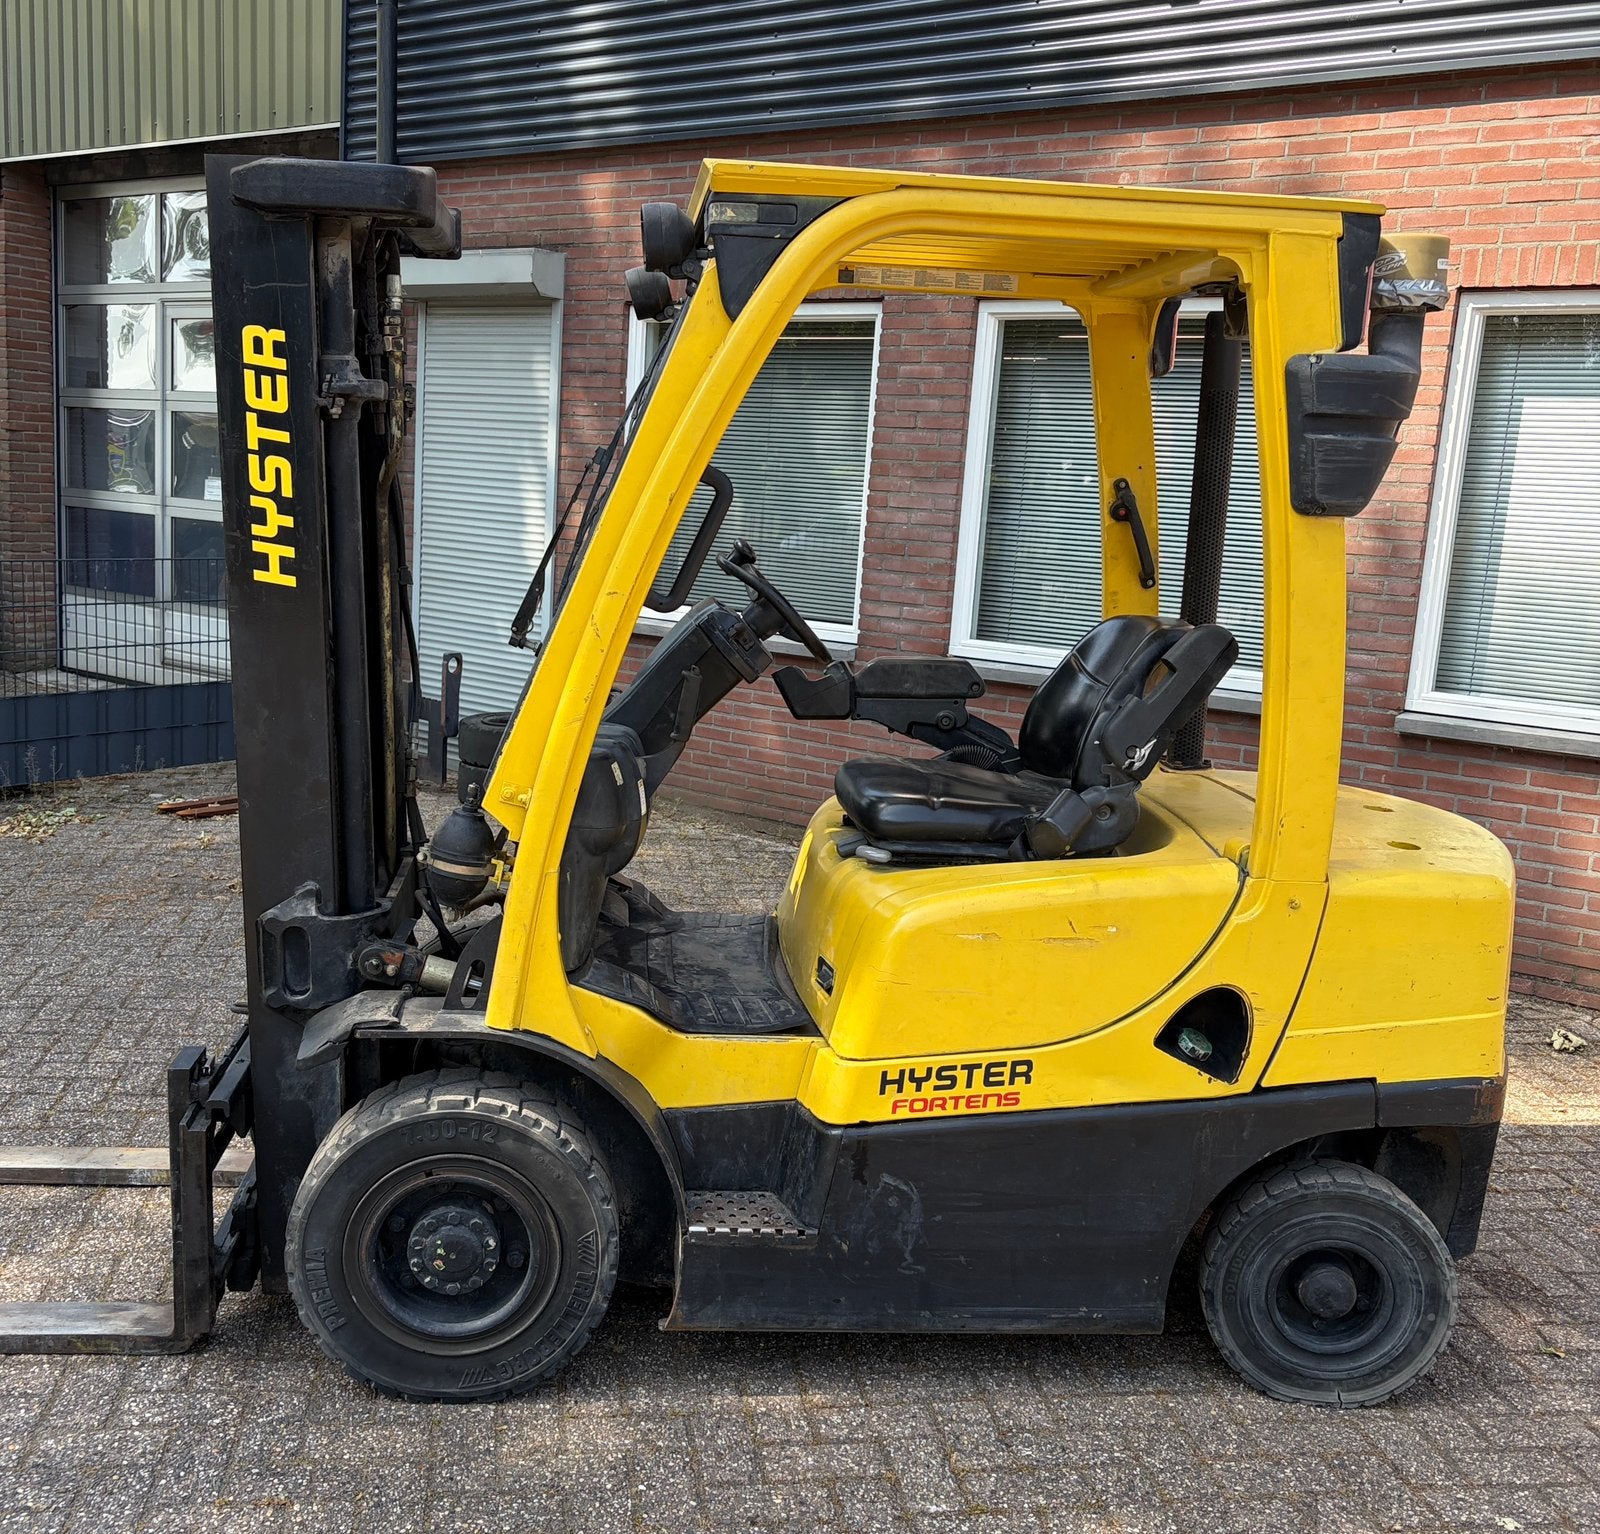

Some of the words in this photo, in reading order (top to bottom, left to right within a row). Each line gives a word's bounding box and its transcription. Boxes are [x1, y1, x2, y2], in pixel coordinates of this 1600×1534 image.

[1381, 259, 1408, 271] SPIN
[242, 324, 297, 588] HYSTER
[879, 1059, 1033, 1095] HYSTER
[891, 1092, 1021, 1114] FORTENS
[400, 1119, 500, 1146] 7.00-12
[304, 1246, 347, 1332] PREMIA
[496, 1270, 597, 1382] TRELLEBORG
